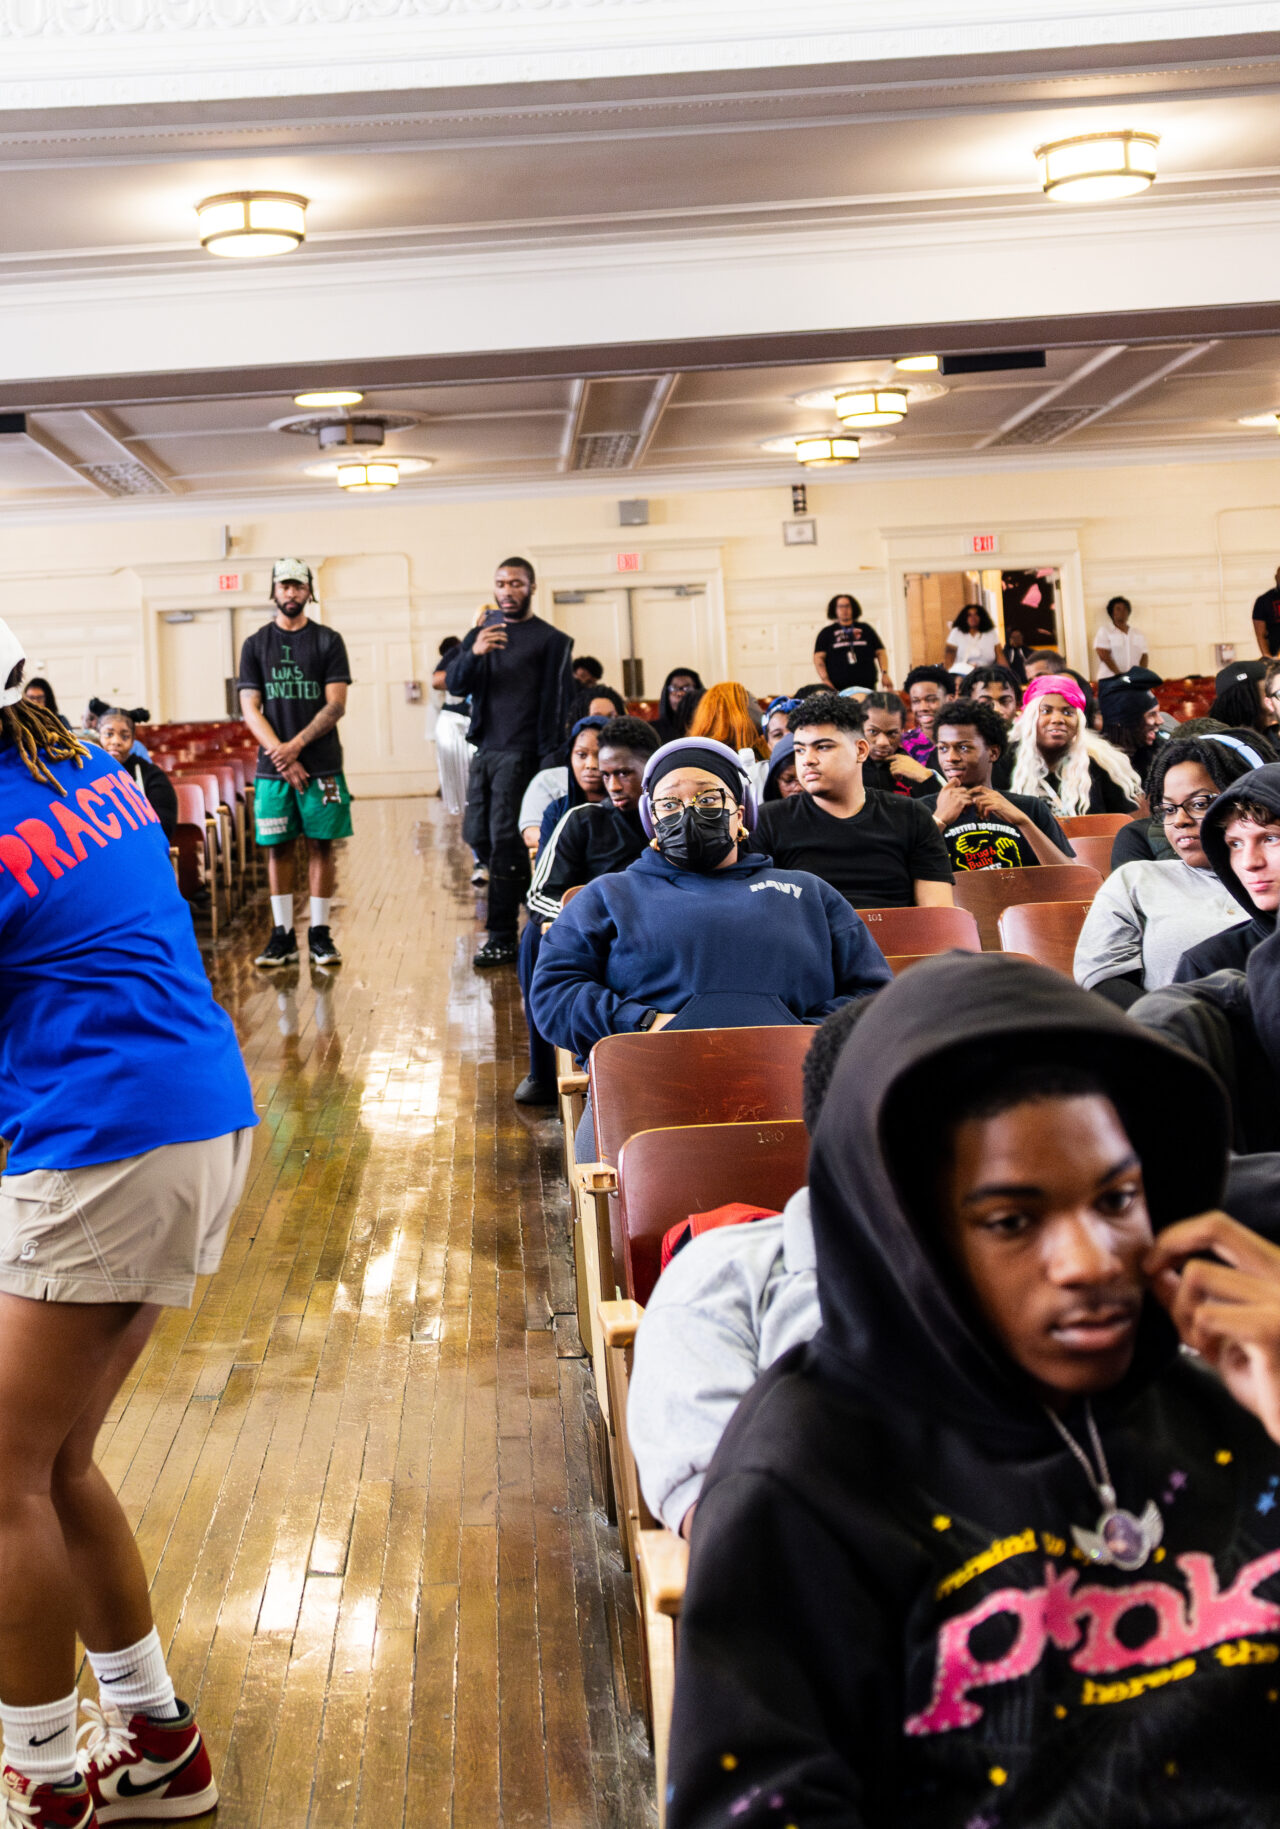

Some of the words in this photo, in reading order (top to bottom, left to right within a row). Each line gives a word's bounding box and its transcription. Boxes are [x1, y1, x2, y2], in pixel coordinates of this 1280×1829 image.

[973, 535, 995, 552] EXIT
[281, 645, 296, 664] I
[272, 665, 304, 680] WAS
[265, 680, 321, 700] INVITED
[965, 849, 989, 863] Drug
[968, 856, 994, 870] Bully
[749, 879, 803, 900] NAVY
[867, 913, 883, 922] 101
